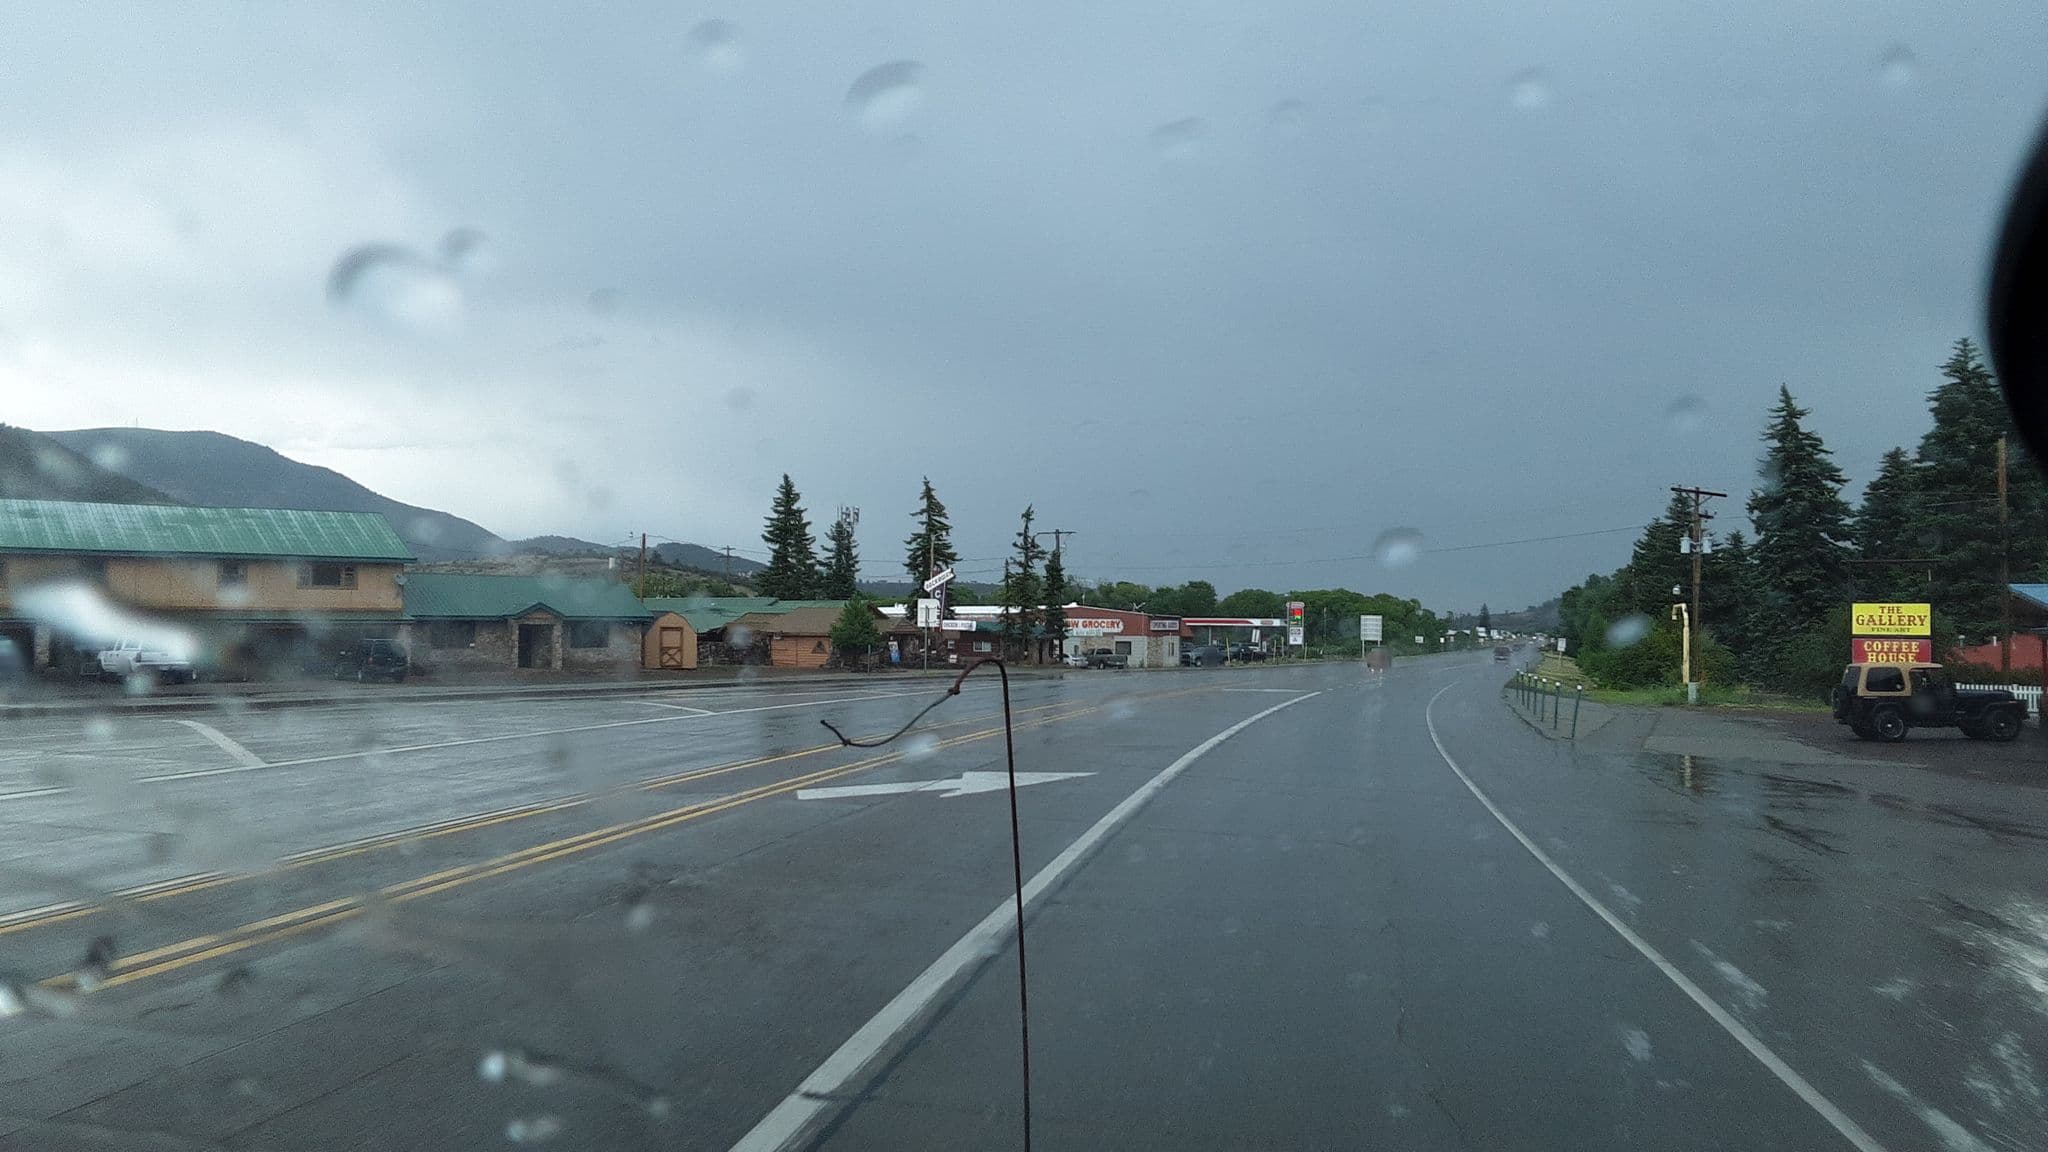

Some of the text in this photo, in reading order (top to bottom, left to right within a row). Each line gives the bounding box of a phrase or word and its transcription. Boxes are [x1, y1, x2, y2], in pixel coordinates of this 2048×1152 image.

[1879, 606, 1903, 614] THE
[1082, 620, 1121, 629] GROCERY
[1856, 614, 1928, 626] GALLERY
[1863, 641, 1920, 652] COFFEE
[1867, 652, 1917, 663] HOUSE
